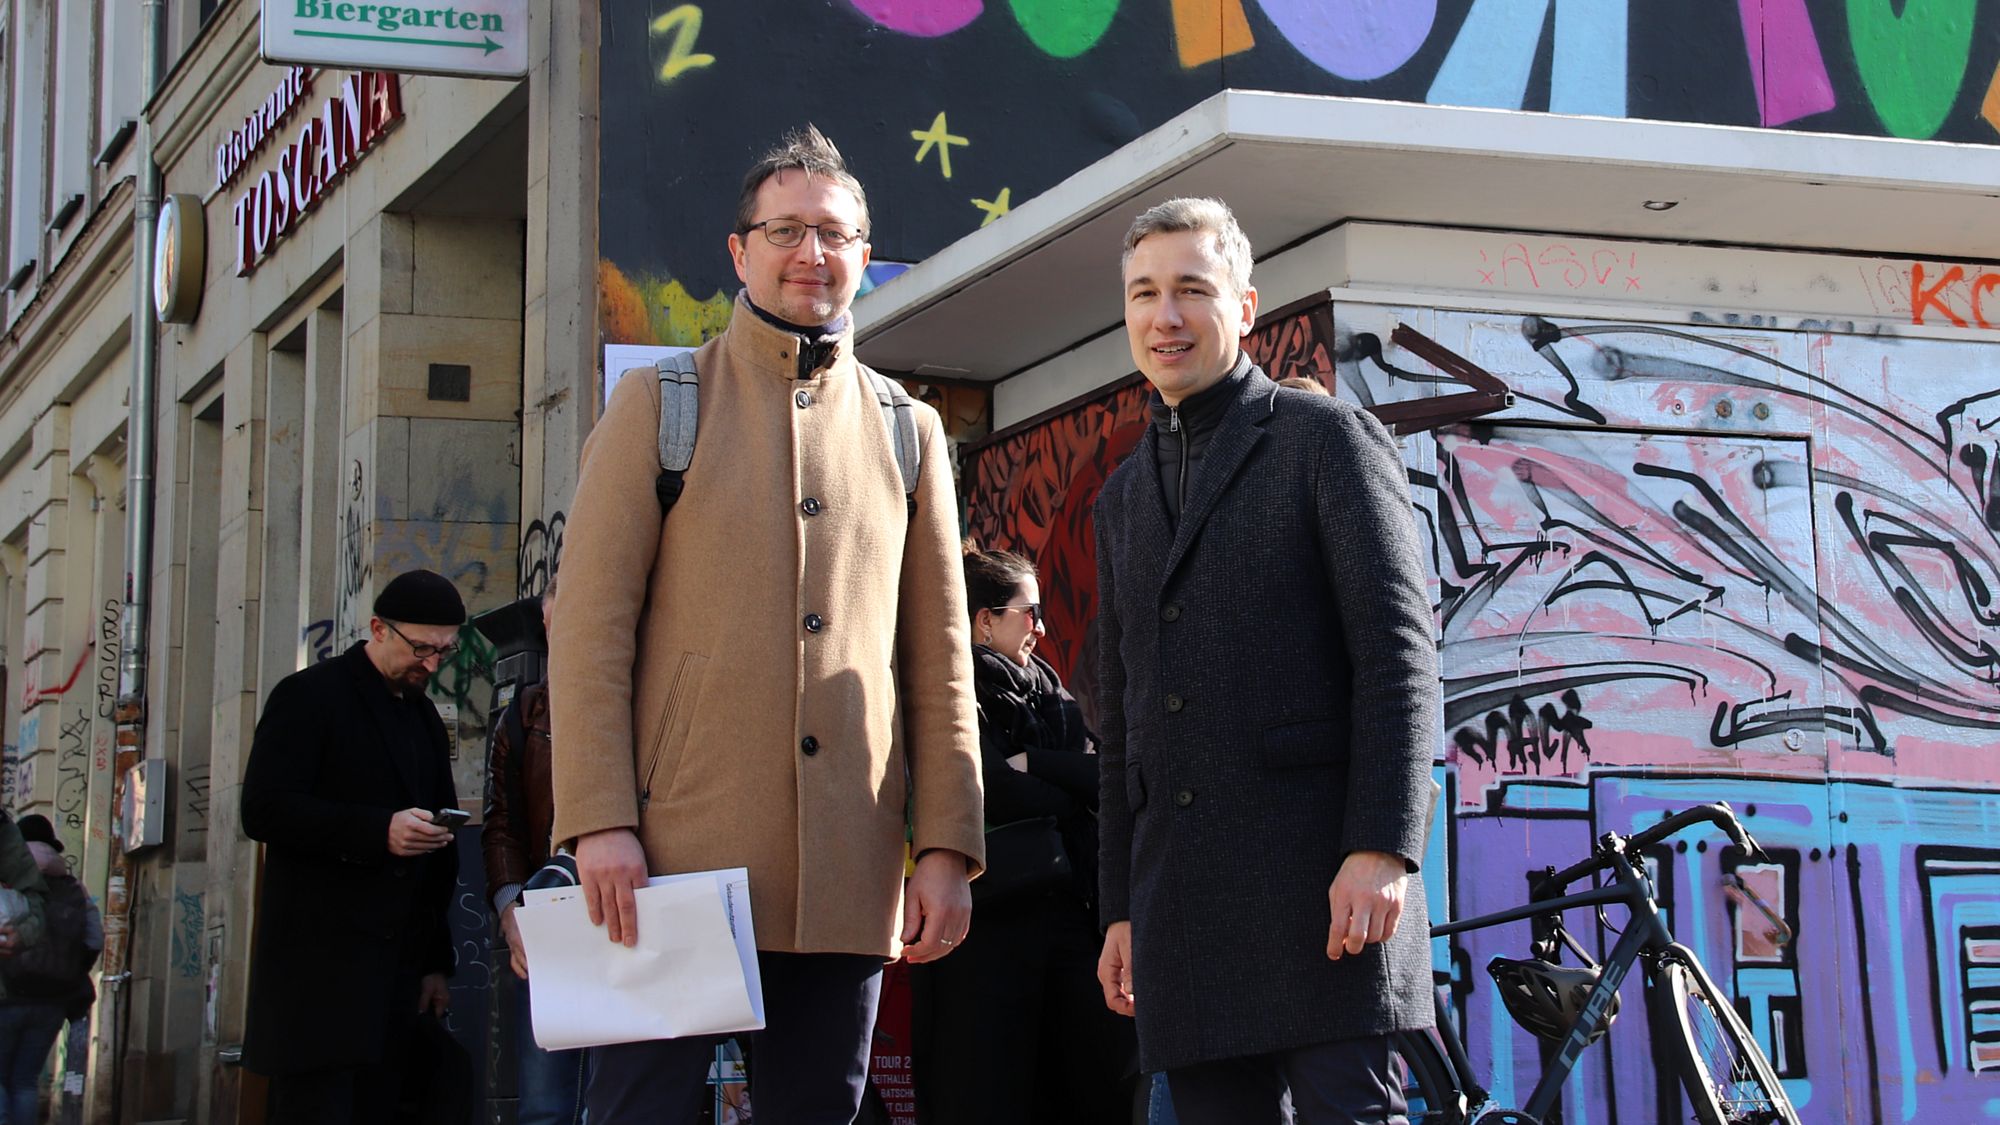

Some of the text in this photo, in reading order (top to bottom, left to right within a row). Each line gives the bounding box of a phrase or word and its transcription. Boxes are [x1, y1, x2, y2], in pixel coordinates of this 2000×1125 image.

[294, 0, 505, 32] Biergarten
[217, 66, 305, 188] Ristorante
[235, 71, 402, 277] TOSCANA
[874, 1055, 901, 1069] TOUR
[1559, 960, 1625, 1070] CUBE
